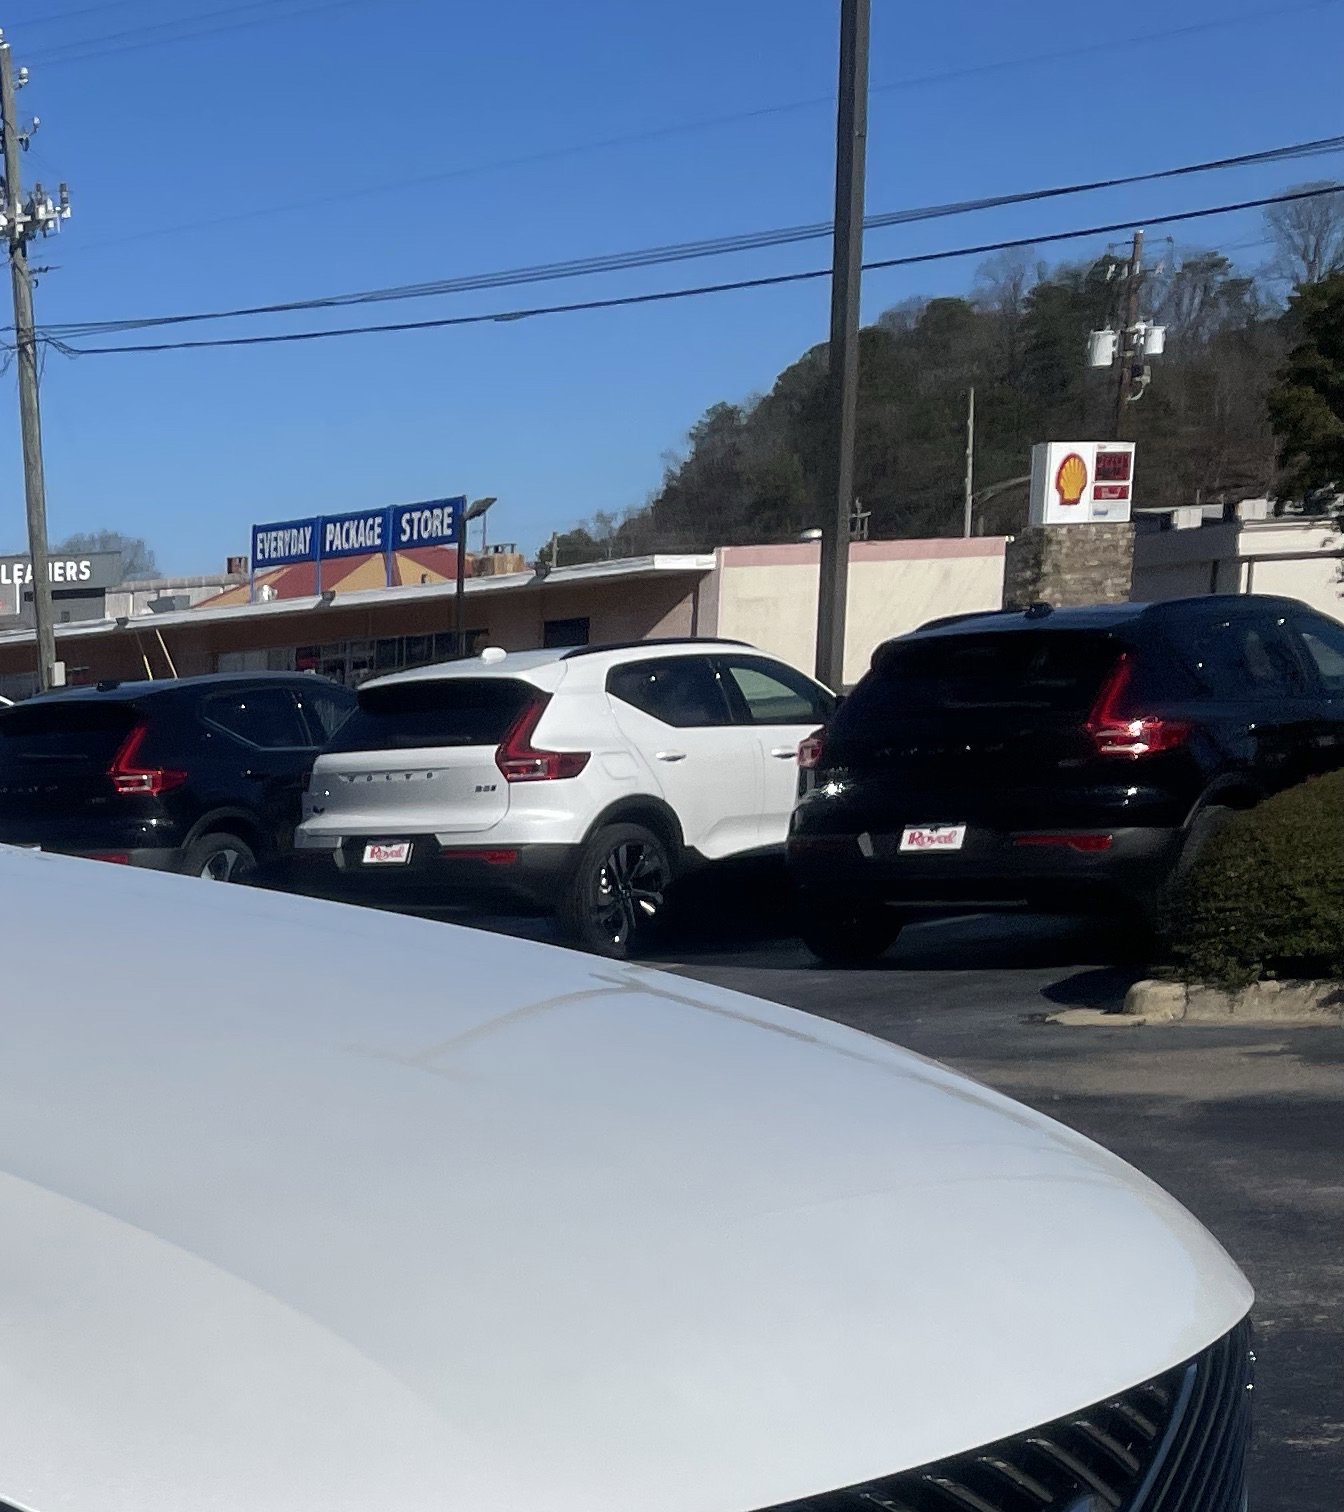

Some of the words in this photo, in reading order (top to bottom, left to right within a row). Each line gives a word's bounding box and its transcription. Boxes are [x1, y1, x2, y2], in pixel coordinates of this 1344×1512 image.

[256, 526, 312, 560] EVERYDAY
[325, 516, 383, 552] PACKAGE
[400, 505, 453, 542] STORE
